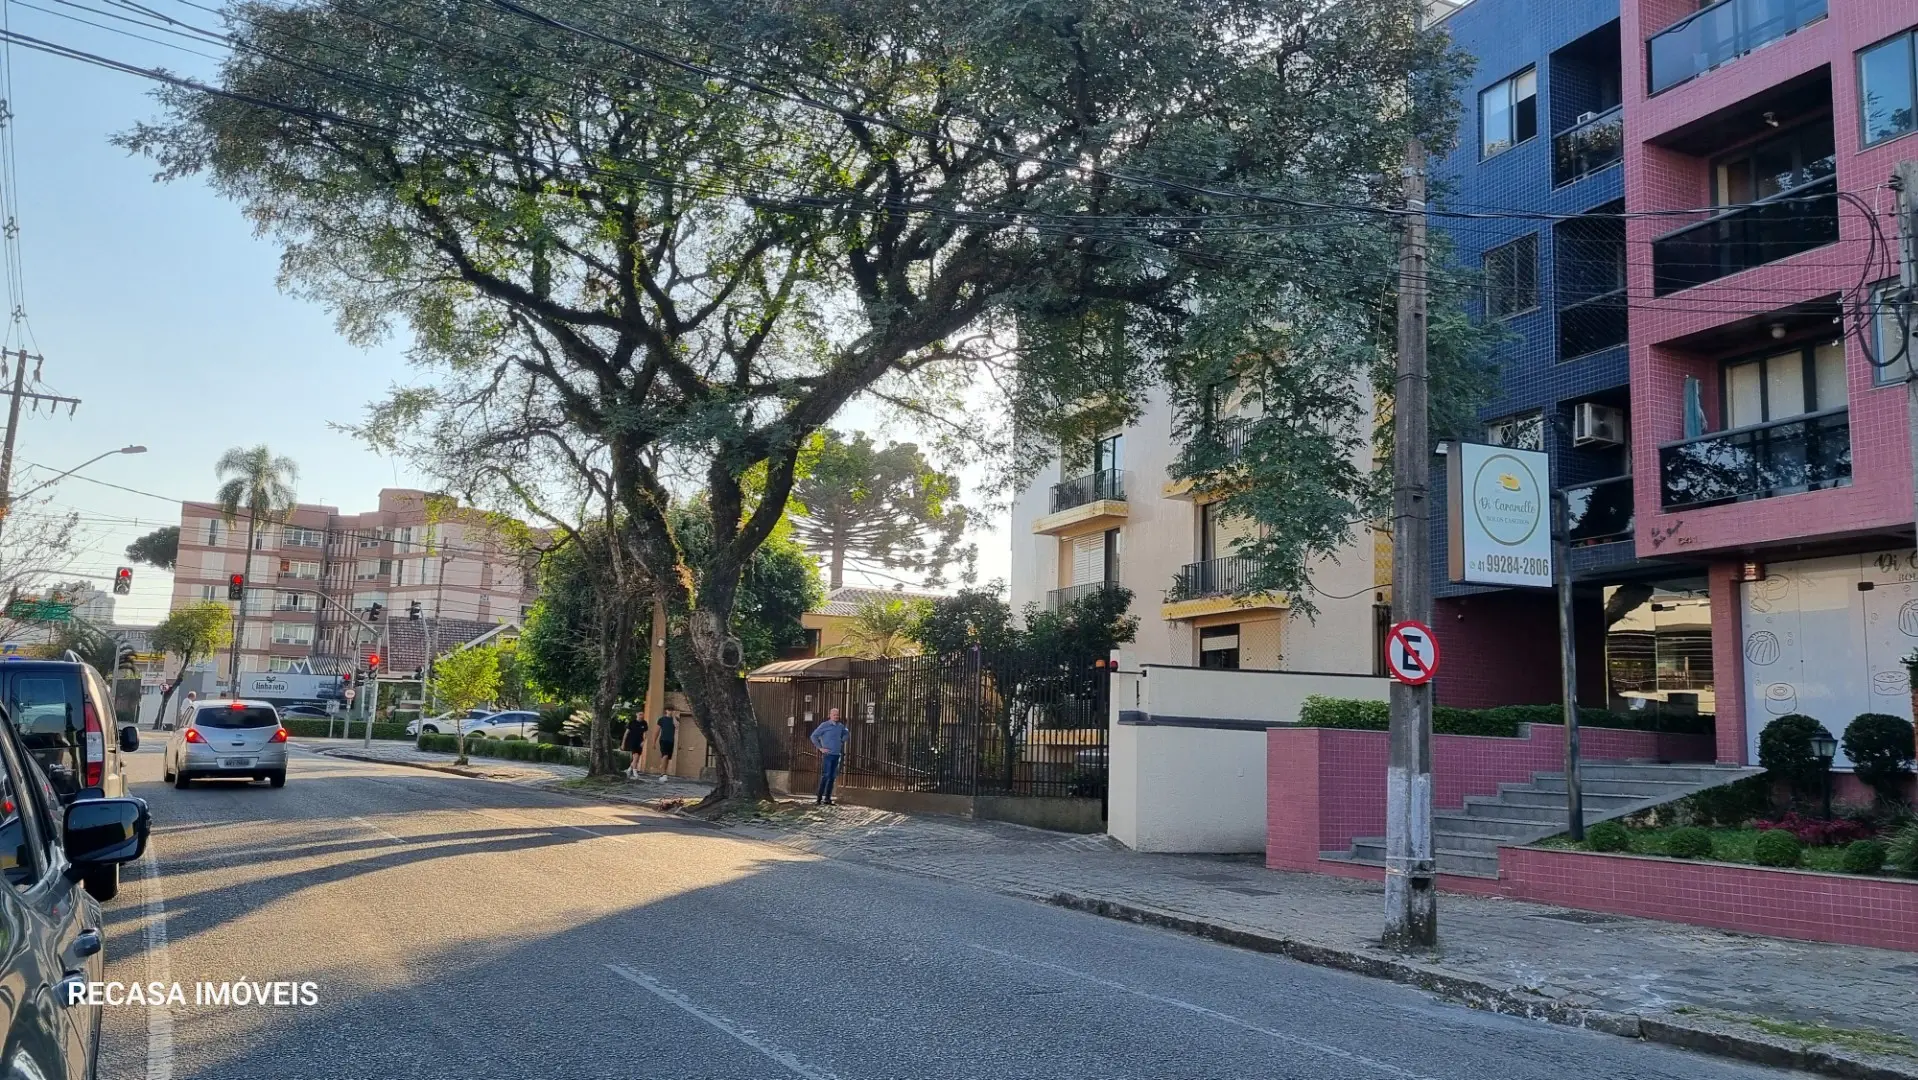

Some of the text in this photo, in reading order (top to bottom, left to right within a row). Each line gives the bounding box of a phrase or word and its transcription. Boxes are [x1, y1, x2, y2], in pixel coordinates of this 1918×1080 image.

[1479, 496, 1536, 514] Di Caramelle
[1478, 554, 1549, 577] 41 99284-2806
[1873, 553, 1900, 573] Di
[1402, 635, 1422, 671] E
[256, 681, 272, 690] linha
